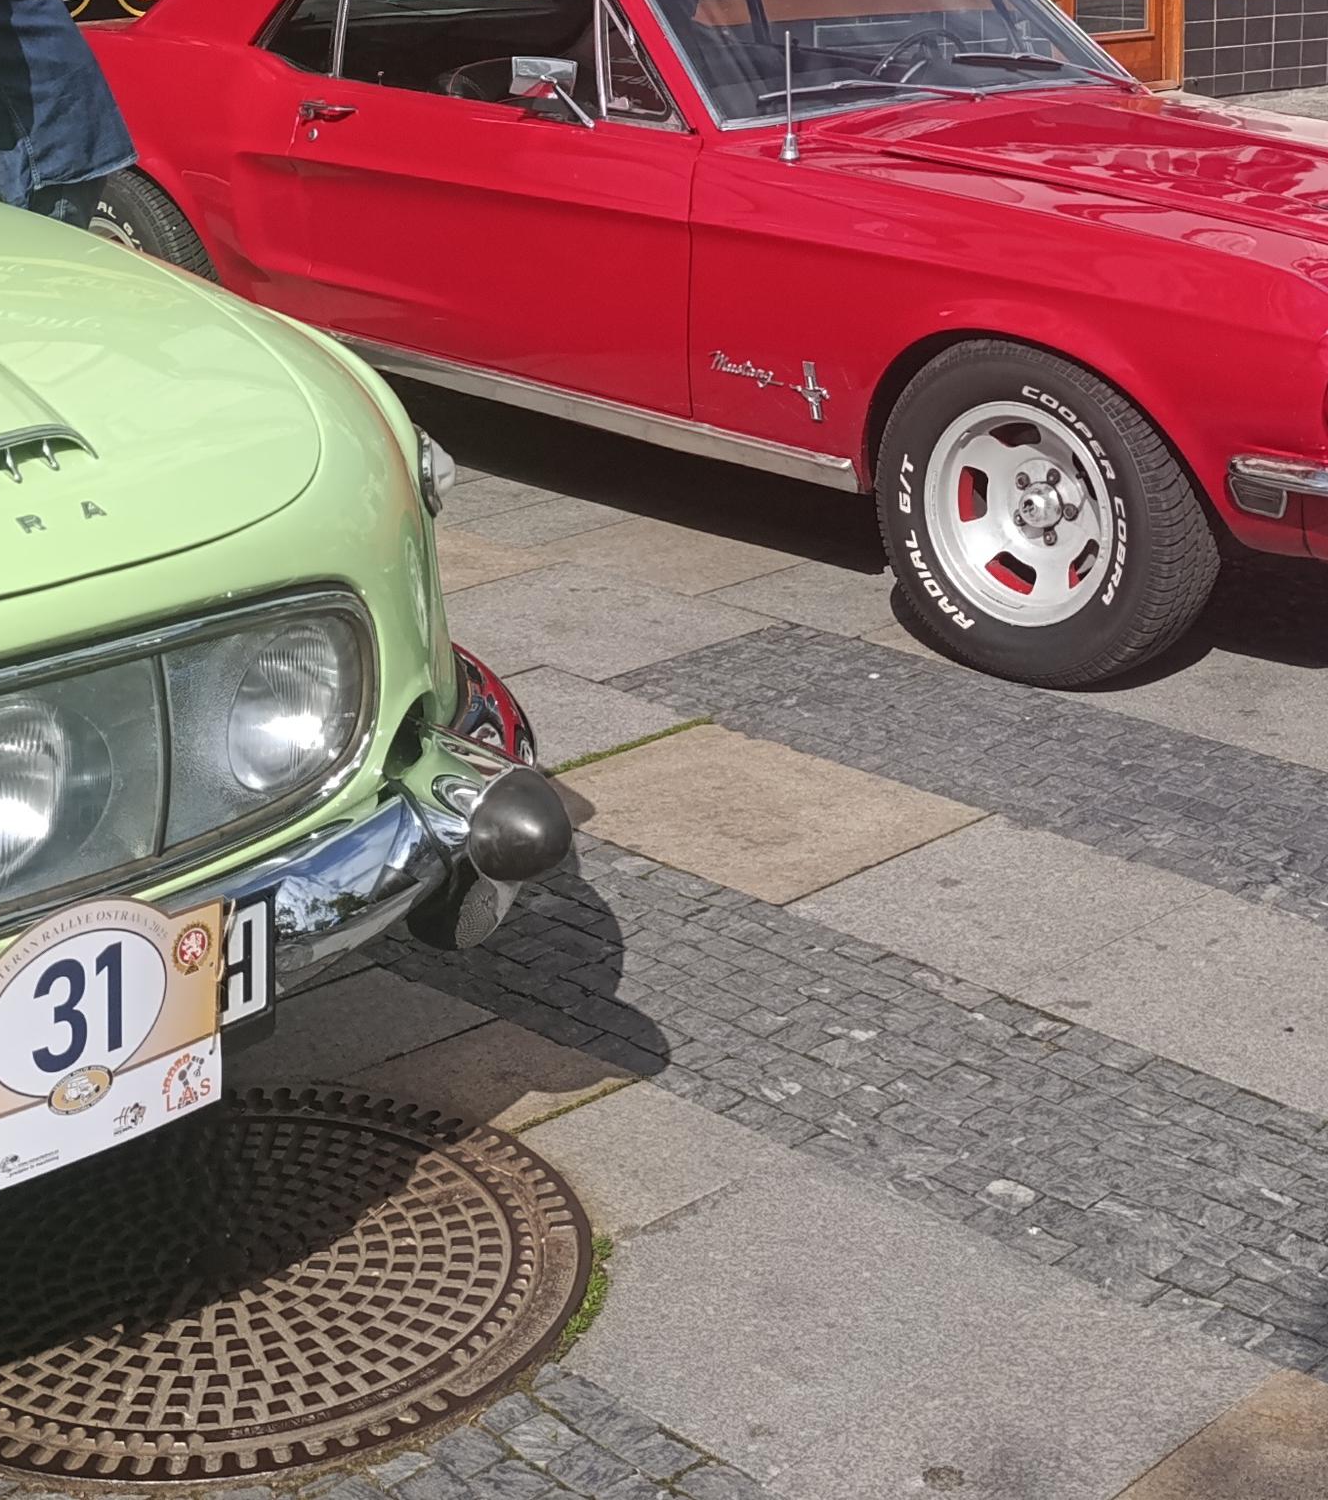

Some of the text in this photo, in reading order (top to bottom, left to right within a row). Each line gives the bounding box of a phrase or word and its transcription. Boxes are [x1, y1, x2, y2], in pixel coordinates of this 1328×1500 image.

[709, 350, 784, 387] Mustang
[1022, 385, 1116, 480] COOPER
[905, 530, 975, 630] RADIAL
[1102, 496, 1127, 605] COBRA
[41, 911, 93, 944] RALLYE
[96, 909, 150, 928] OSTRAVA
[32, 941, 123, 1073] 31
